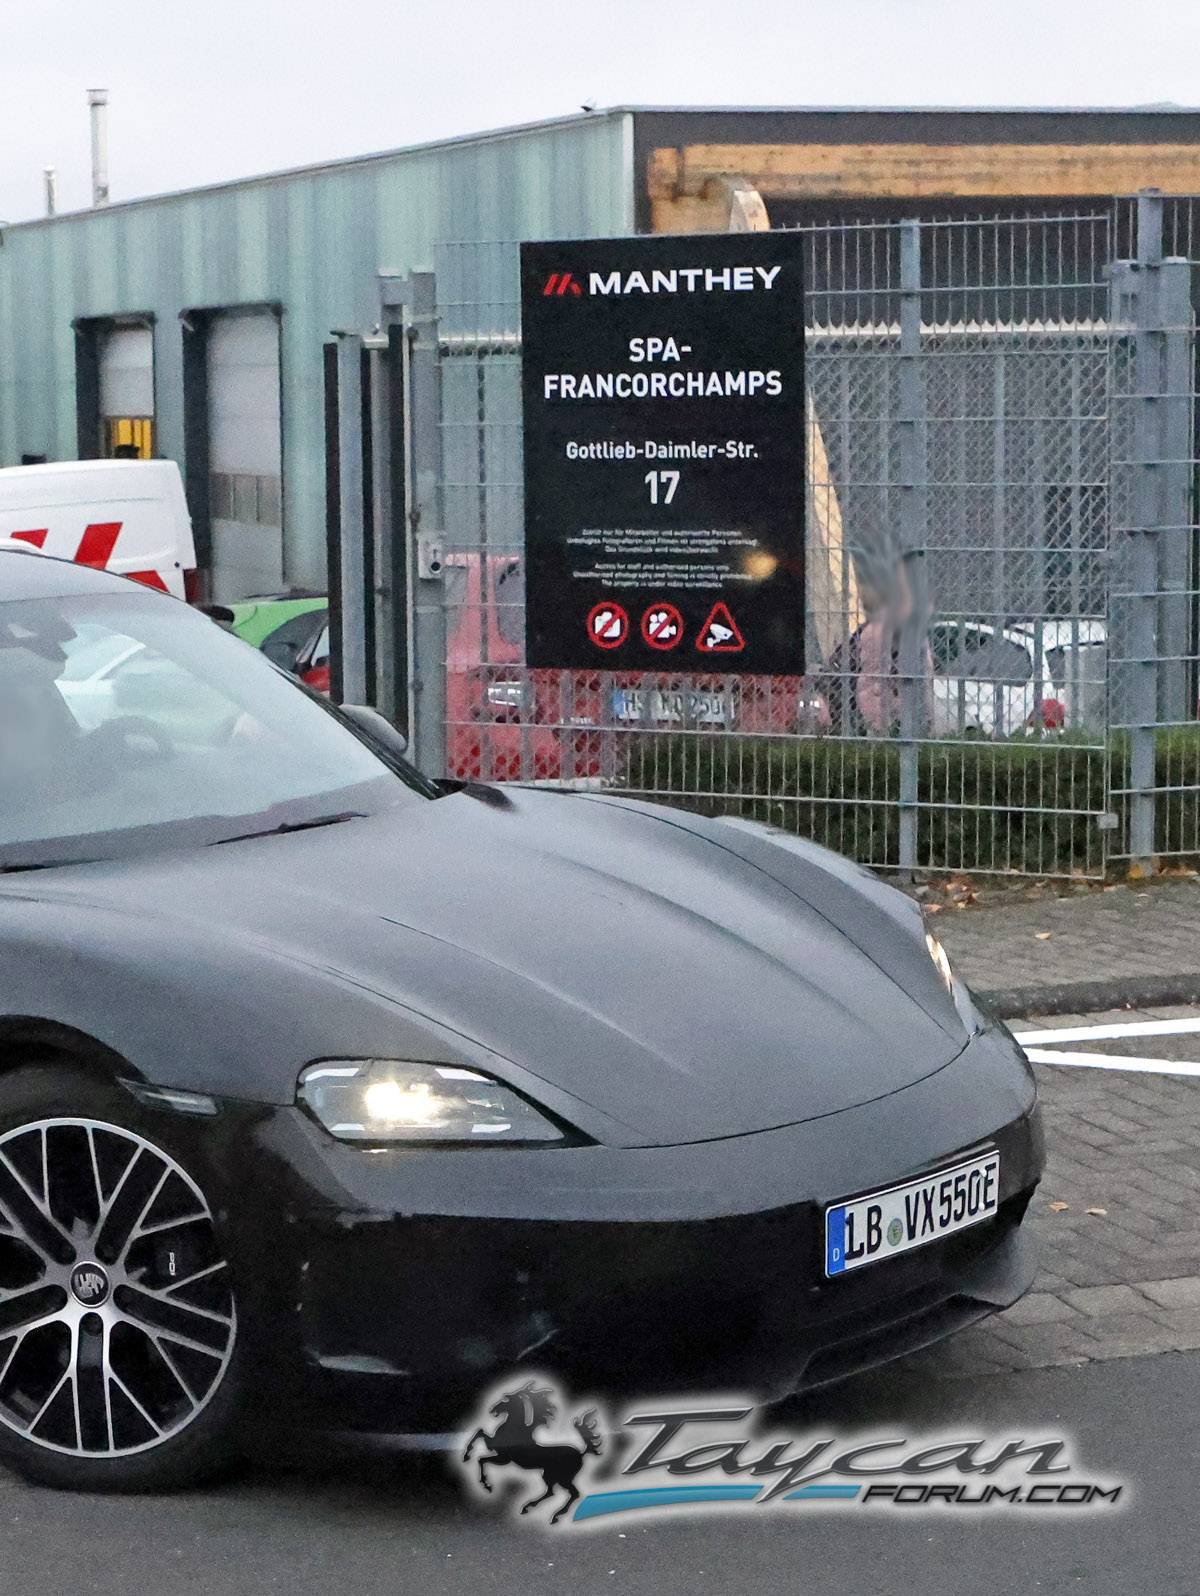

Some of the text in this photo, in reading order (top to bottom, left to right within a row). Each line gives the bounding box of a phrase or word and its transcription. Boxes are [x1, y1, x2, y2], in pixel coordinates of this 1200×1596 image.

[588, 266, 782, 296] MANTHEY
[628, 336, 692, 363] SPA-
[543, 370, 783, 399] FRANCORCHAMPS
[565, 440, 759, 461] Gottlieb-Daimler-Str.
[644, 470, 681, 505] 17
